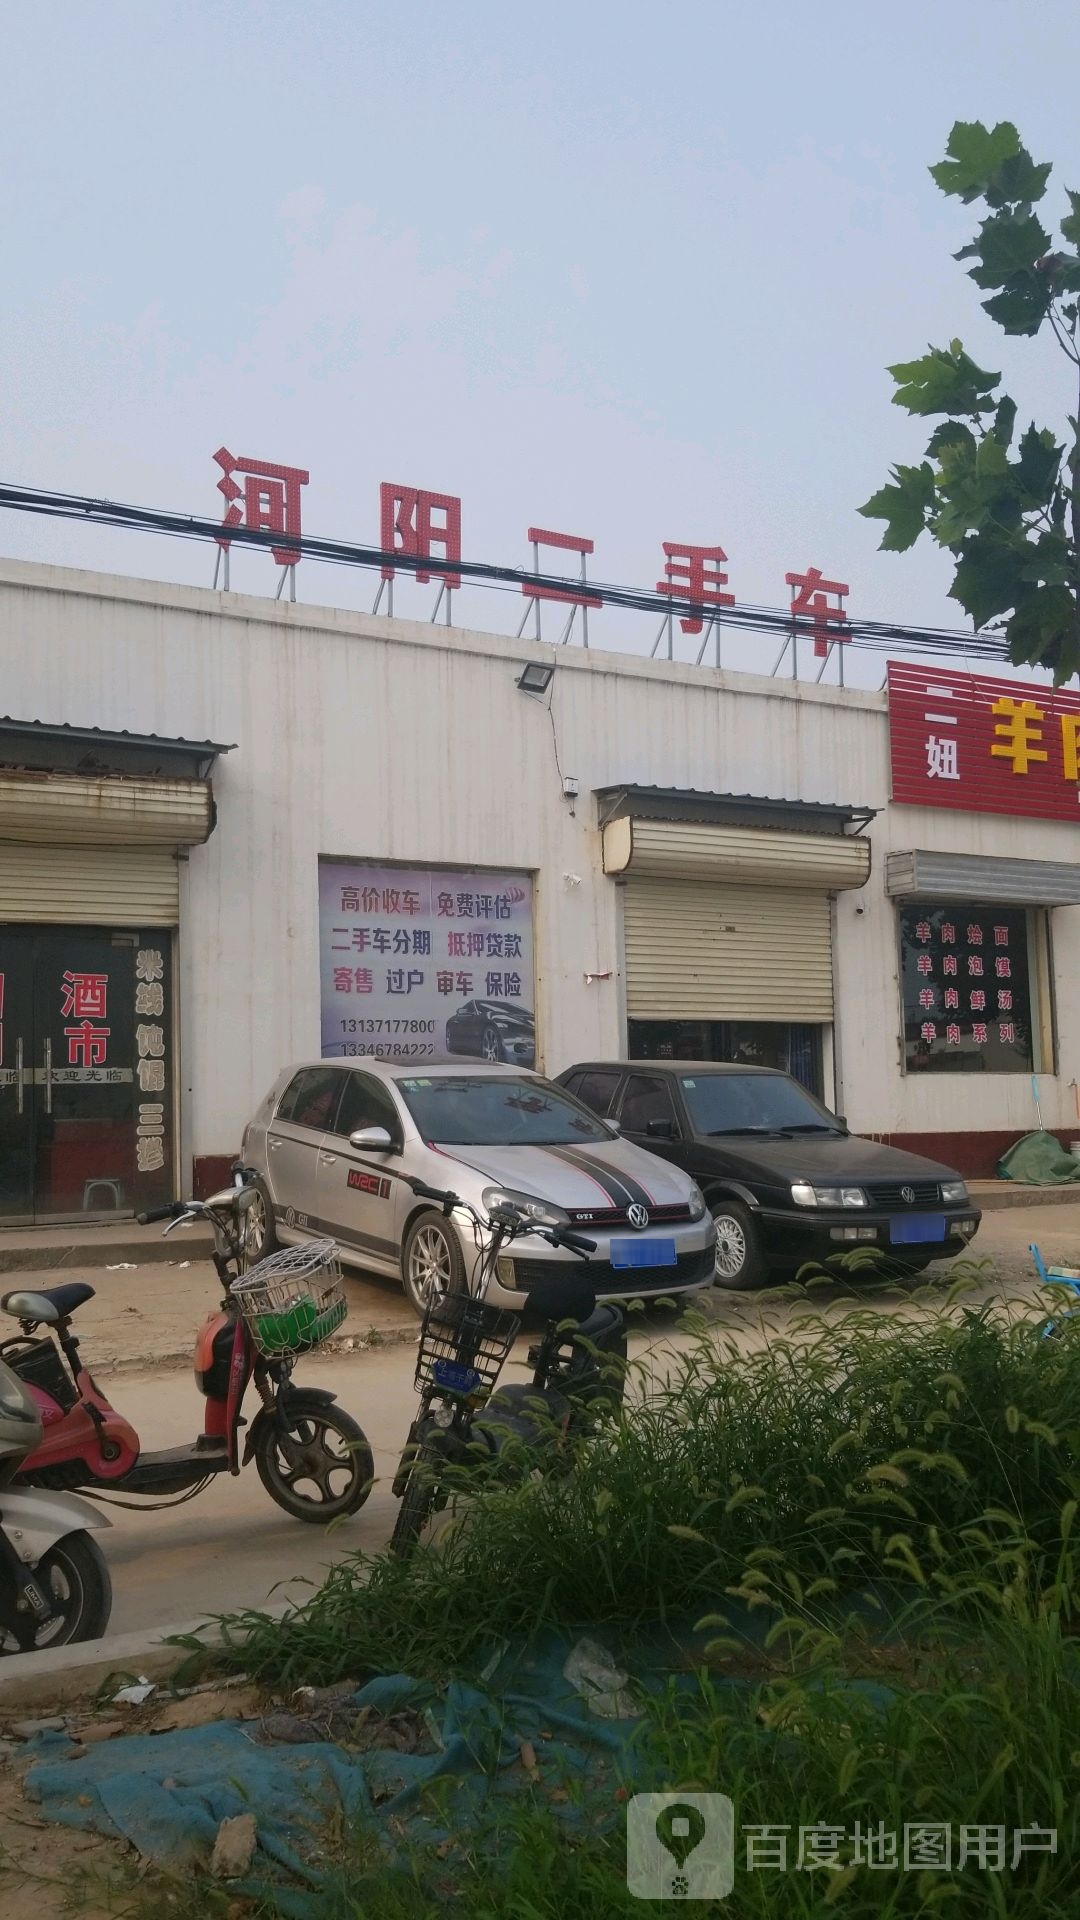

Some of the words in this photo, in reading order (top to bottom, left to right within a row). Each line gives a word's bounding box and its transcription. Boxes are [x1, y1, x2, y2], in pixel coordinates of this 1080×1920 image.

[212, 446, 852, 658] 河阳二手车
[924, 686, 961, 781] 二妞
[340, 886, 421, 916] 高价收车
[436, 891, 512, 920] 免费评估
[331, 927, 431, 956] 二手车分期
[447, 931, 522, 959] 抵押贷款
[916, 922, 1009, 946] 羊肉烩面
[333, 966, 374, 994] 寄售
[386, 968, 425, 995] 过户
[436, 970, 474, 997] 审车
[484, 971, 522, 997] 保险
[917, 955, 1012, 978] 羊肉泡馍
[919, 988, 1013, 1011] 羊肉鲜汤
[60, 969, 111, 1068] 酒市
[340, 1019, 435, 1034] 13137177800
[921, 1022, 1015, 1044] 羊肉系列
